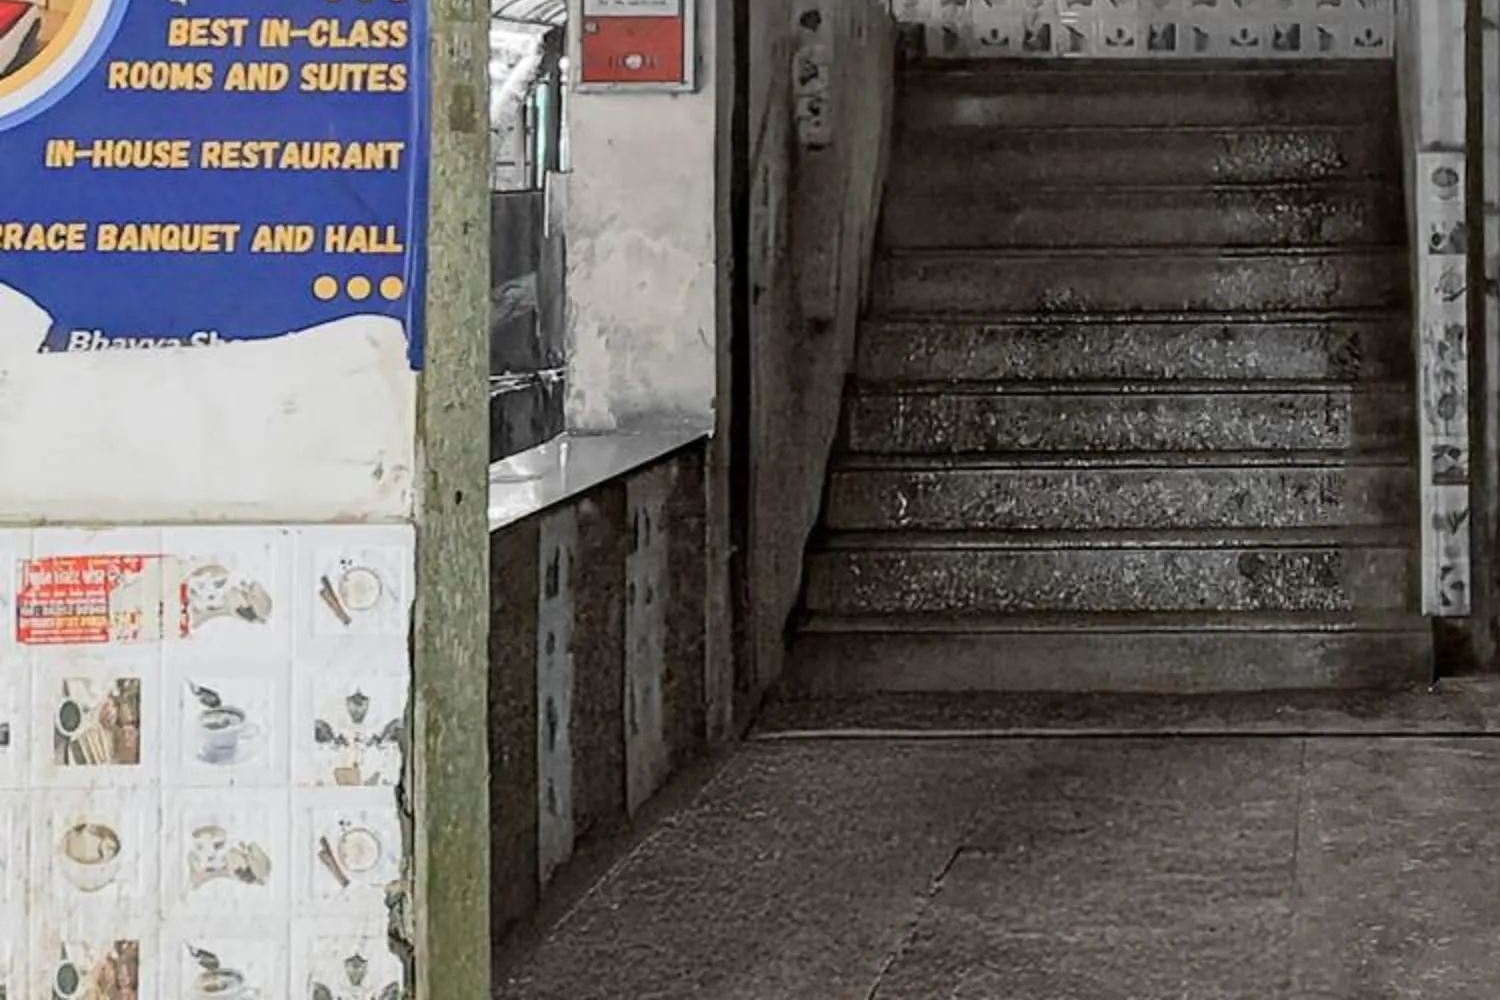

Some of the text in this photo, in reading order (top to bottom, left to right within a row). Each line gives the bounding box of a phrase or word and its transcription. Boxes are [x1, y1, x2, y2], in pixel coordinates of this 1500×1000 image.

[168, 19, 409, 48] BEST IN-CLASS
[108, 61, 407, 92] ROOMS AND SUITES
[45, 139, 404, 170] IN-HOUSE RESTAURANT
[0, 223, 403, 253] RACE BANQUET AND HALL
